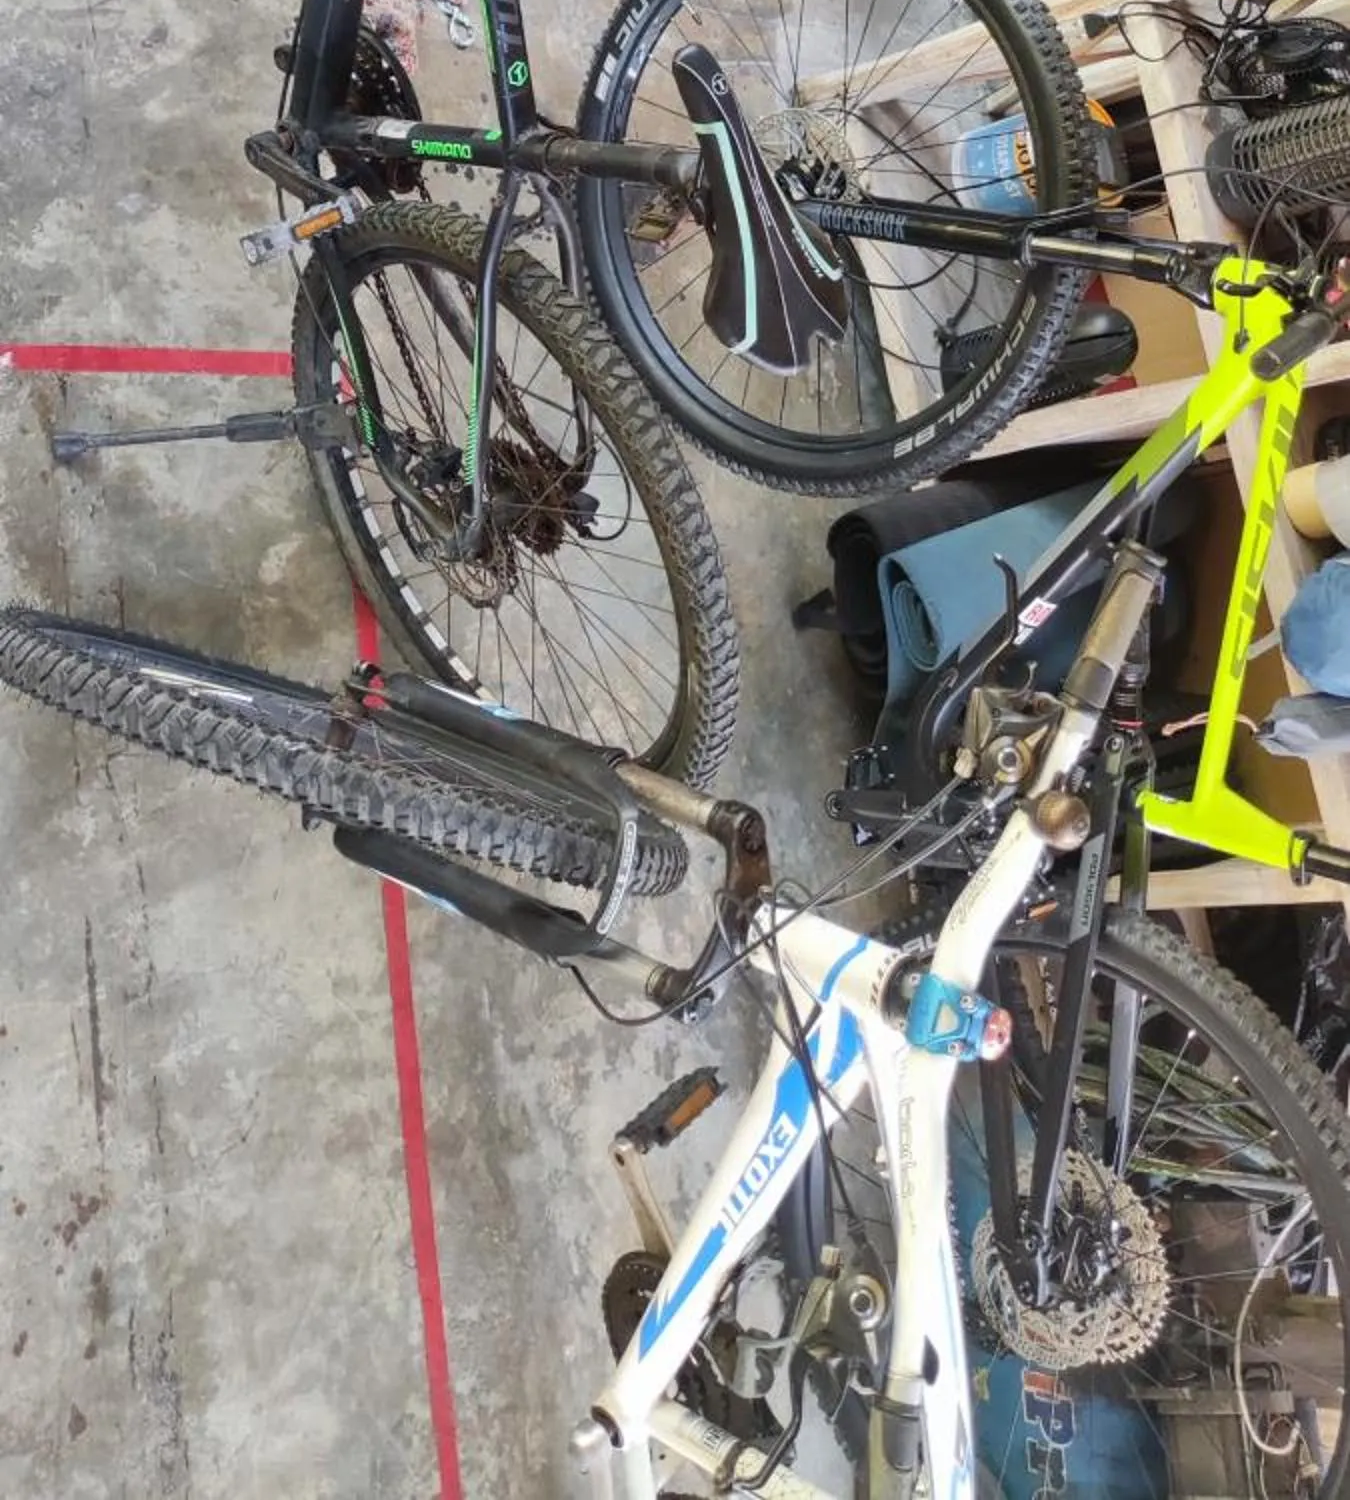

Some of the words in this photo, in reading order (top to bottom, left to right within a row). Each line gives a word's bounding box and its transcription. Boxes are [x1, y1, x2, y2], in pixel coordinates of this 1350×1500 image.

[411, 138, 473, 160] SHIMANO
[893, 294, 1037, 460] SCHWALBE
[1080, 852, 1099, 927] POLYGON
